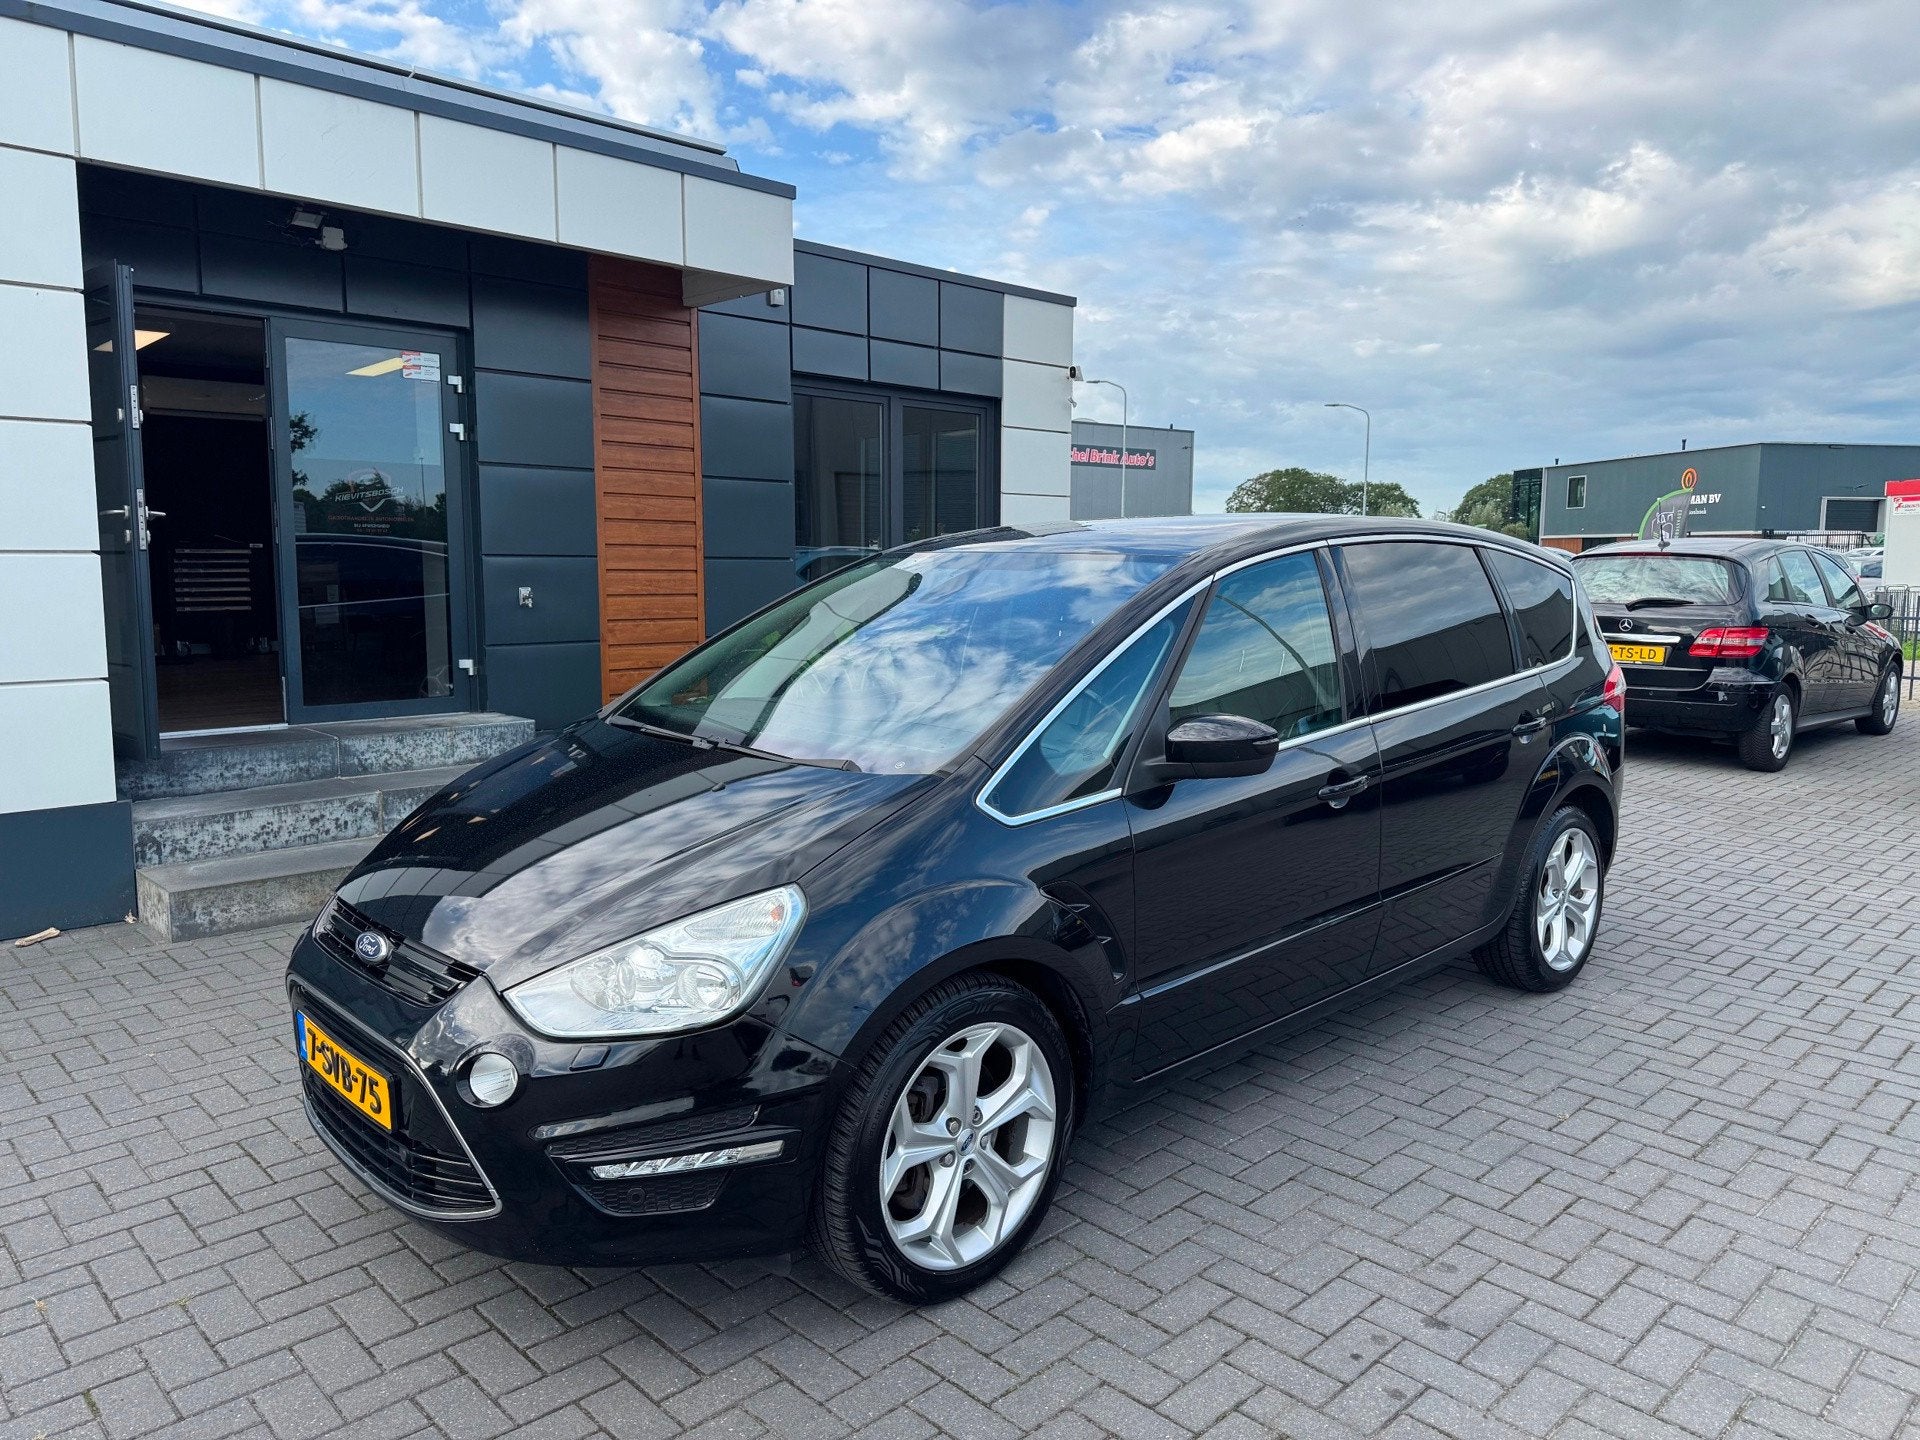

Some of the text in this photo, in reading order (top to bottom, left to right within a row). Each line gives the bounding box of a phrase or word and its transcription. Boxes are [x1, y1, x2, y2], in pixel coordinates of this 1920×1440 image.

[1071, 447, 1155, 467] hel Brink Auto's
[335, 486, 404, 502] KIEVITSBOSCH
[1708, 493, 1722, 504] BV
[359, 935, 378, 955] Ford
[307, 1027, 382, 1115] 7-SVB-75
